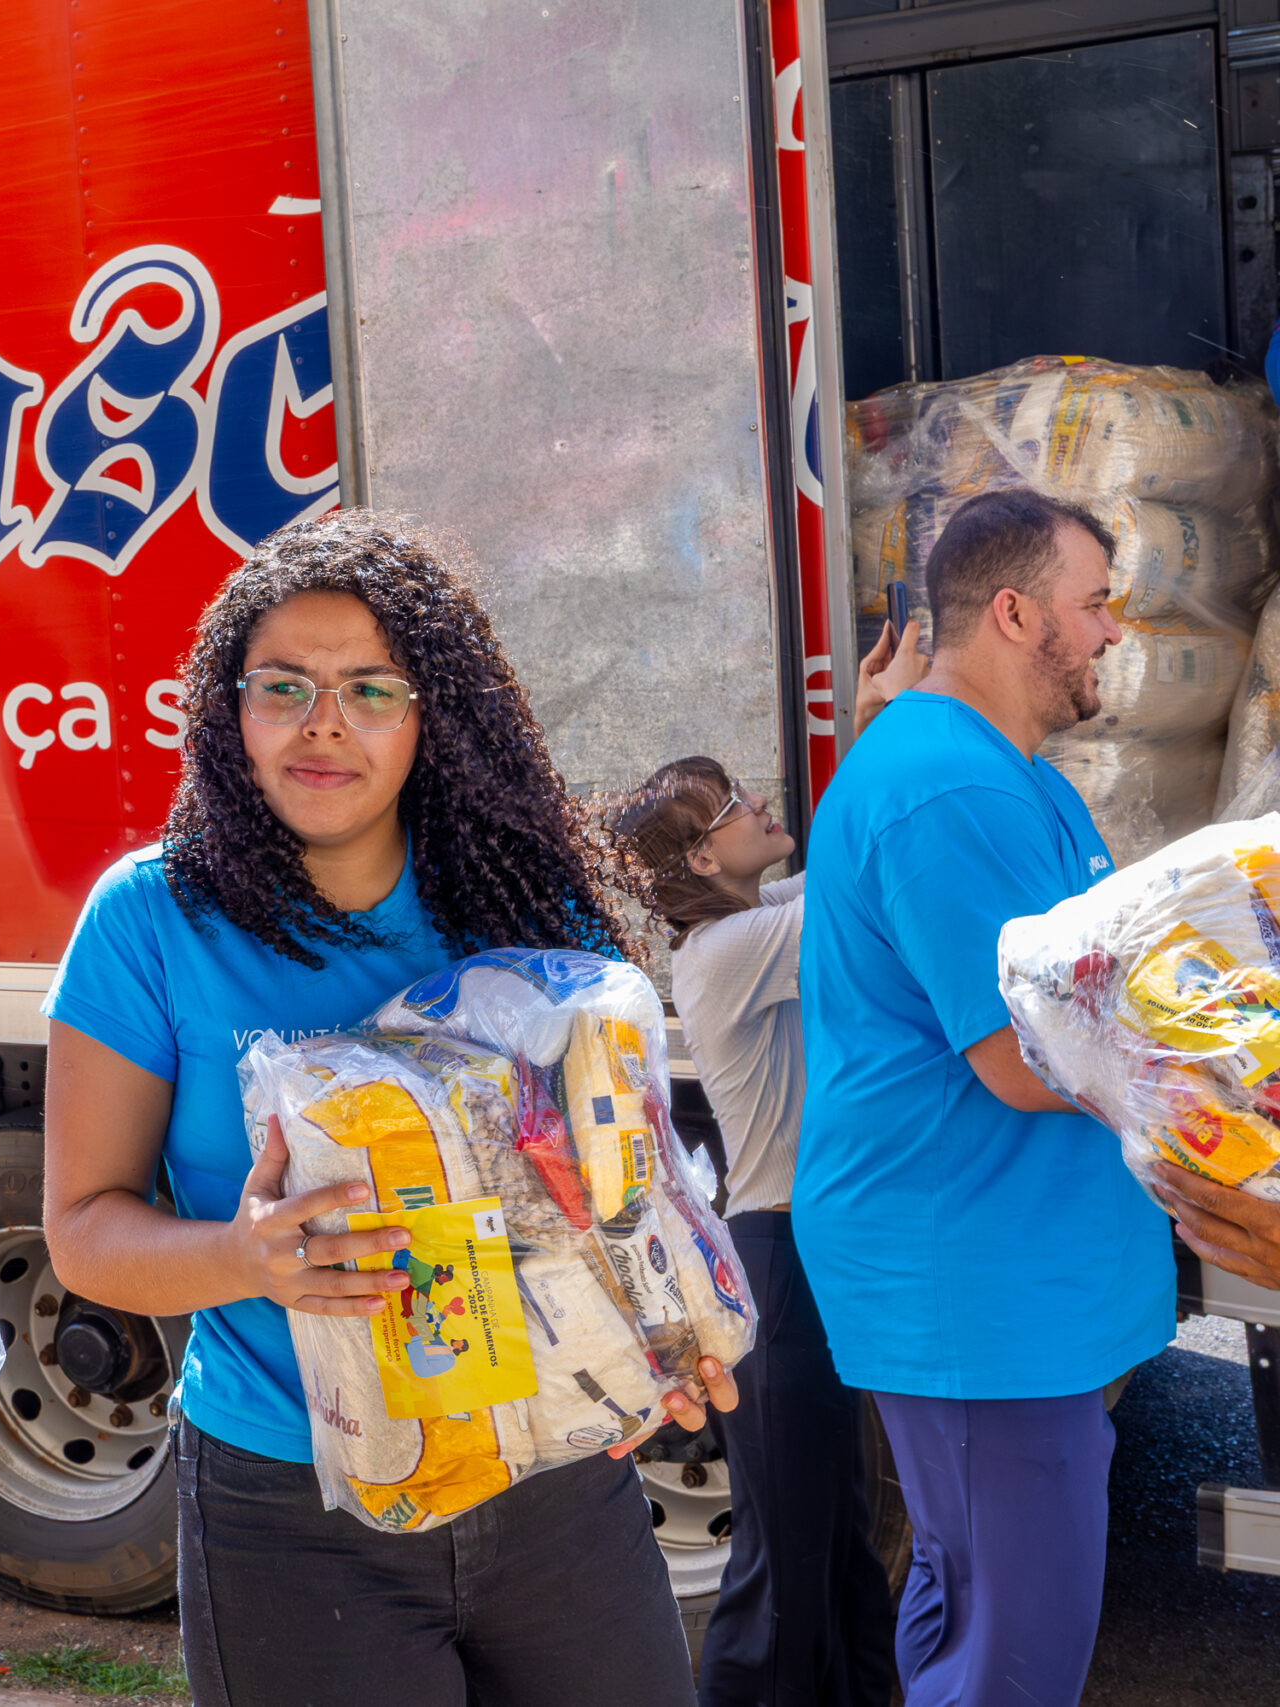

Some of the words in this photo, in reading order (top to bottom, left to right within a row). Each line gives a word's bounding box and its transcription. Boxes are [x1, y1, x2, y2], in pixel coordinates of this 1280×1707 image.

[465, 1239, 485, 1302] ARRECADAÇÃO
[610, 1242, 647, 1319] Chocolate
[468, 1294, 478, 1314] 2025
[479, 1304, 487, 1315] DE
[481, 1317, 498, 1367] ALIMENTOS
